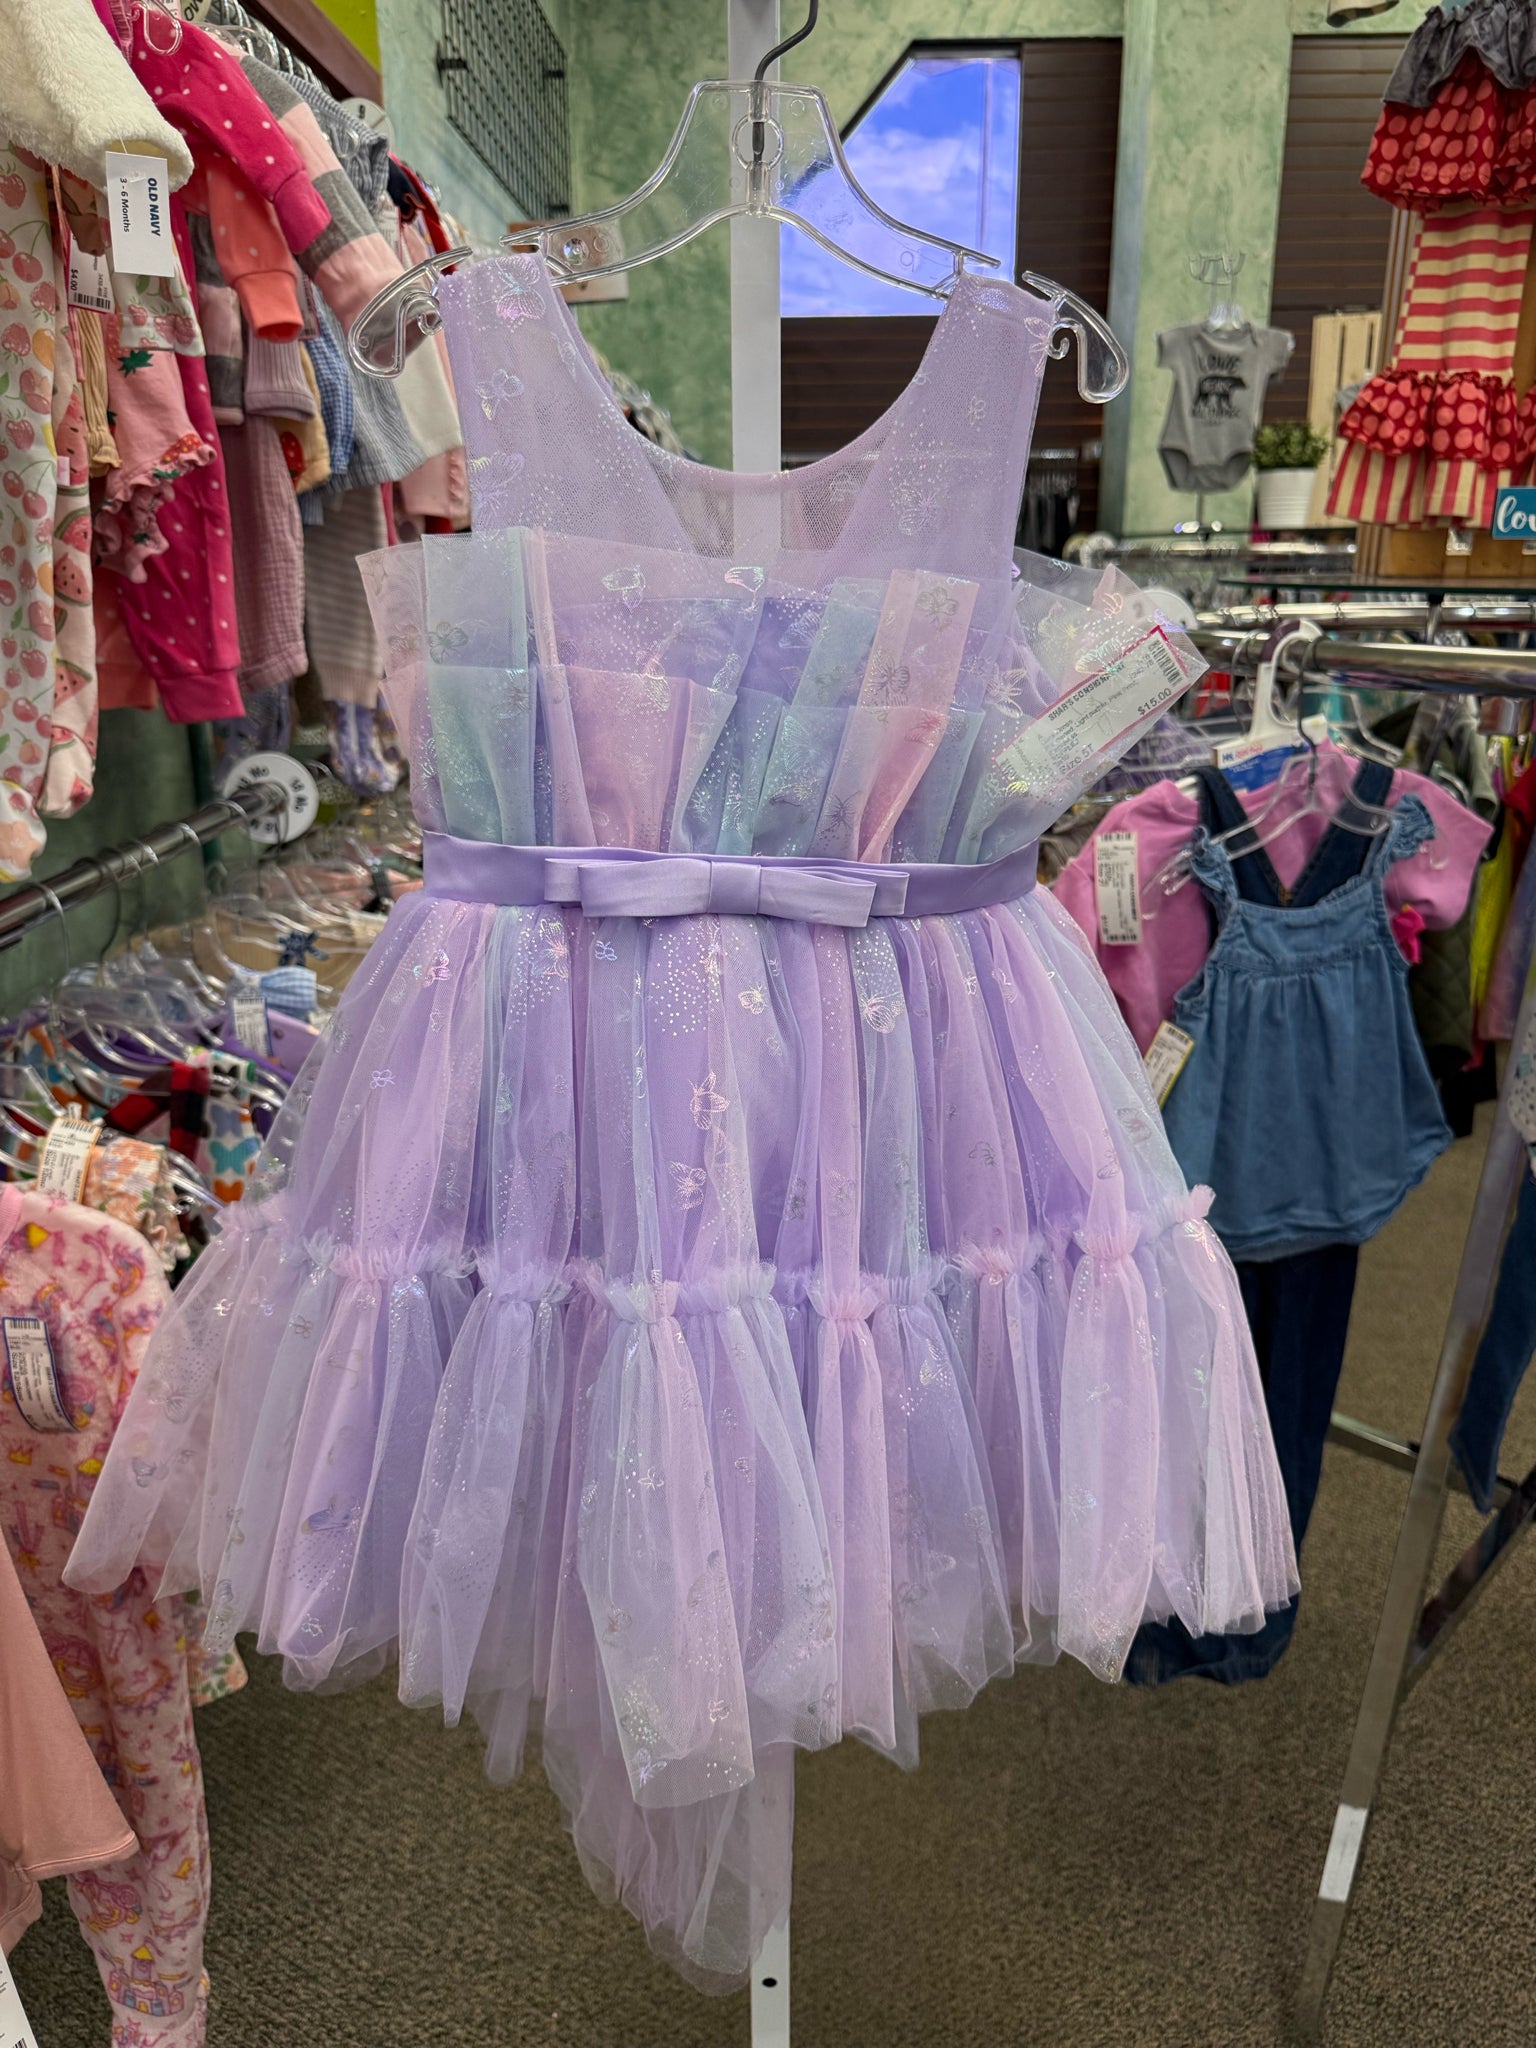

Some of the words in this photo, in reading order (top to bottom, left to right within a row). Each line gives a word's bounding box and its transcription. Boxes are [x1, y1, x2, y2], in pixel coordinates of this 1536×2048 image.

[147, 177, 159, 202] OLD
[121, 198, 132, 233] Months
[149, 203, 161, 237] NAVY
[70, 268, 79, 291] $4.00
[1047, 698, 1074, 721] SHAR'S
[1072, 662, 1125, 701] CONSIGNNT
[1137, 687, 1172, 715] $15.00
[1059, 756, 1082, 775] Size
